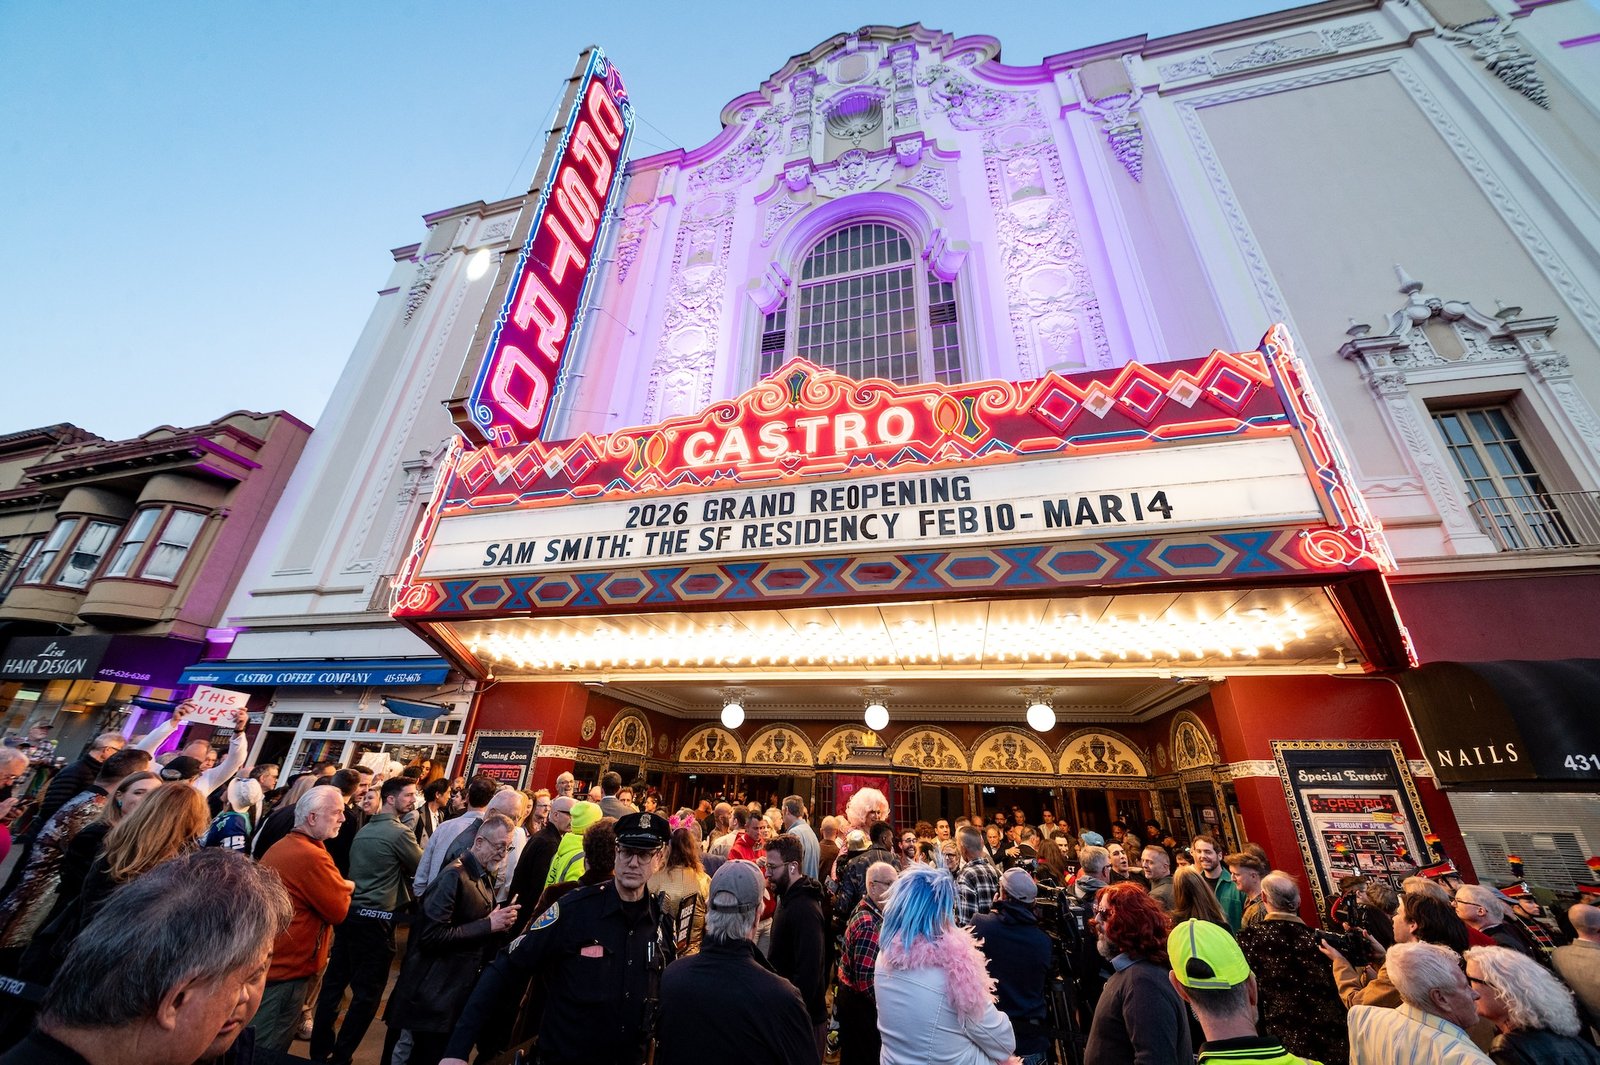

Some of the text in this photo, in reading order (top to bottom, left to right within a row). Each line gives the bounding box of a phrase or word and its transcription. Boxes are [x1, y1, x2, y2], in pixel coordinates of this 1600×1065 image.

[491, 81, 625, 430] CASTRO
[683, 406, 915, 466] CASTRO
[625, 475, 972, 529] 2026 GRAND REOPENING
[483, 541, 537, 567] SAM
[544, 534, 634, 563] SMITH:
[645, 529, 690, 555] THE
[698, 525, 732, 551] SF
[741, 513, 900, 549] RESIDENCY
[37, 641, 67, 658] Lisa
[2, 658, 88, 674] HAIR DESIGN
[98, 668, 151, 681] 415-626-6268
[234, 673, 273, 683] CASTRO
[276, 672, 315, 683] COFFEE
[318, 672, 372, 683] COMPANY
[199, 689, 236, 706] THIS
[481, 750, 527, 761] Coming Soon
[1436, 742, 1519, 767] NAILS
[481, 769, 520, 779] CASTRO
[1298, 768, 1343, 783] Special
[1327, 798, 1383, 809] CASTRO
[1333, 821, 1363, 830] FEBRUARY
[359, 908, 393, 920] CASTRO
